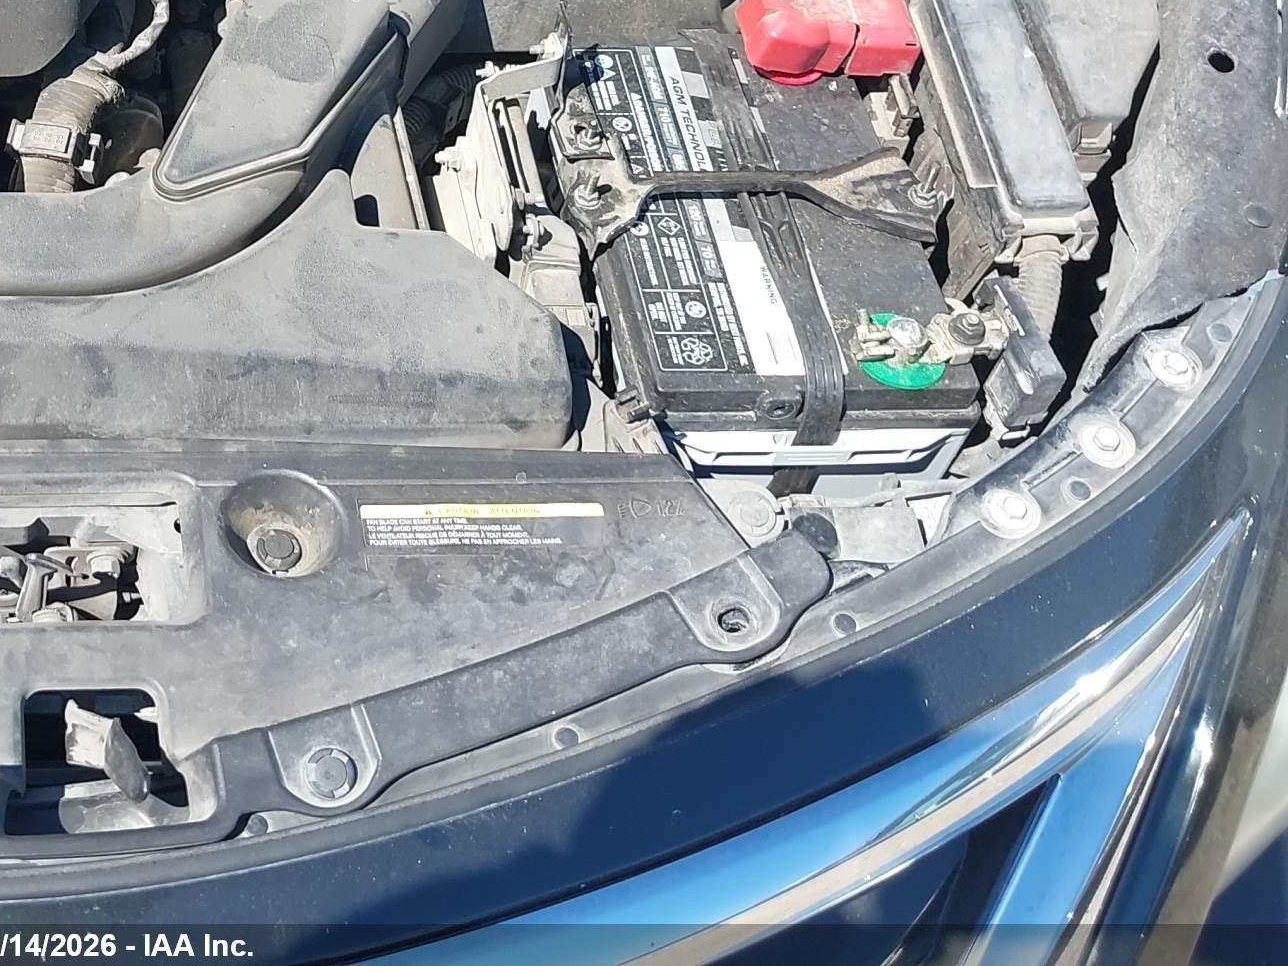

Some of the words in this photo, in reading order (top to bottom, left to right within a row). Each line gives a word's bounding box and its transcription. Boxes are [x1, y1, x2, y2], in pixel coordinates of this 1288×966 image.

[670, 75, 687, 107] AGM
[657, 106, 672, 123] 710
[688, 204, 702, 221] 120
[700, 246, 714, 259] 70
[759, 266, 778, 304] WARNING
